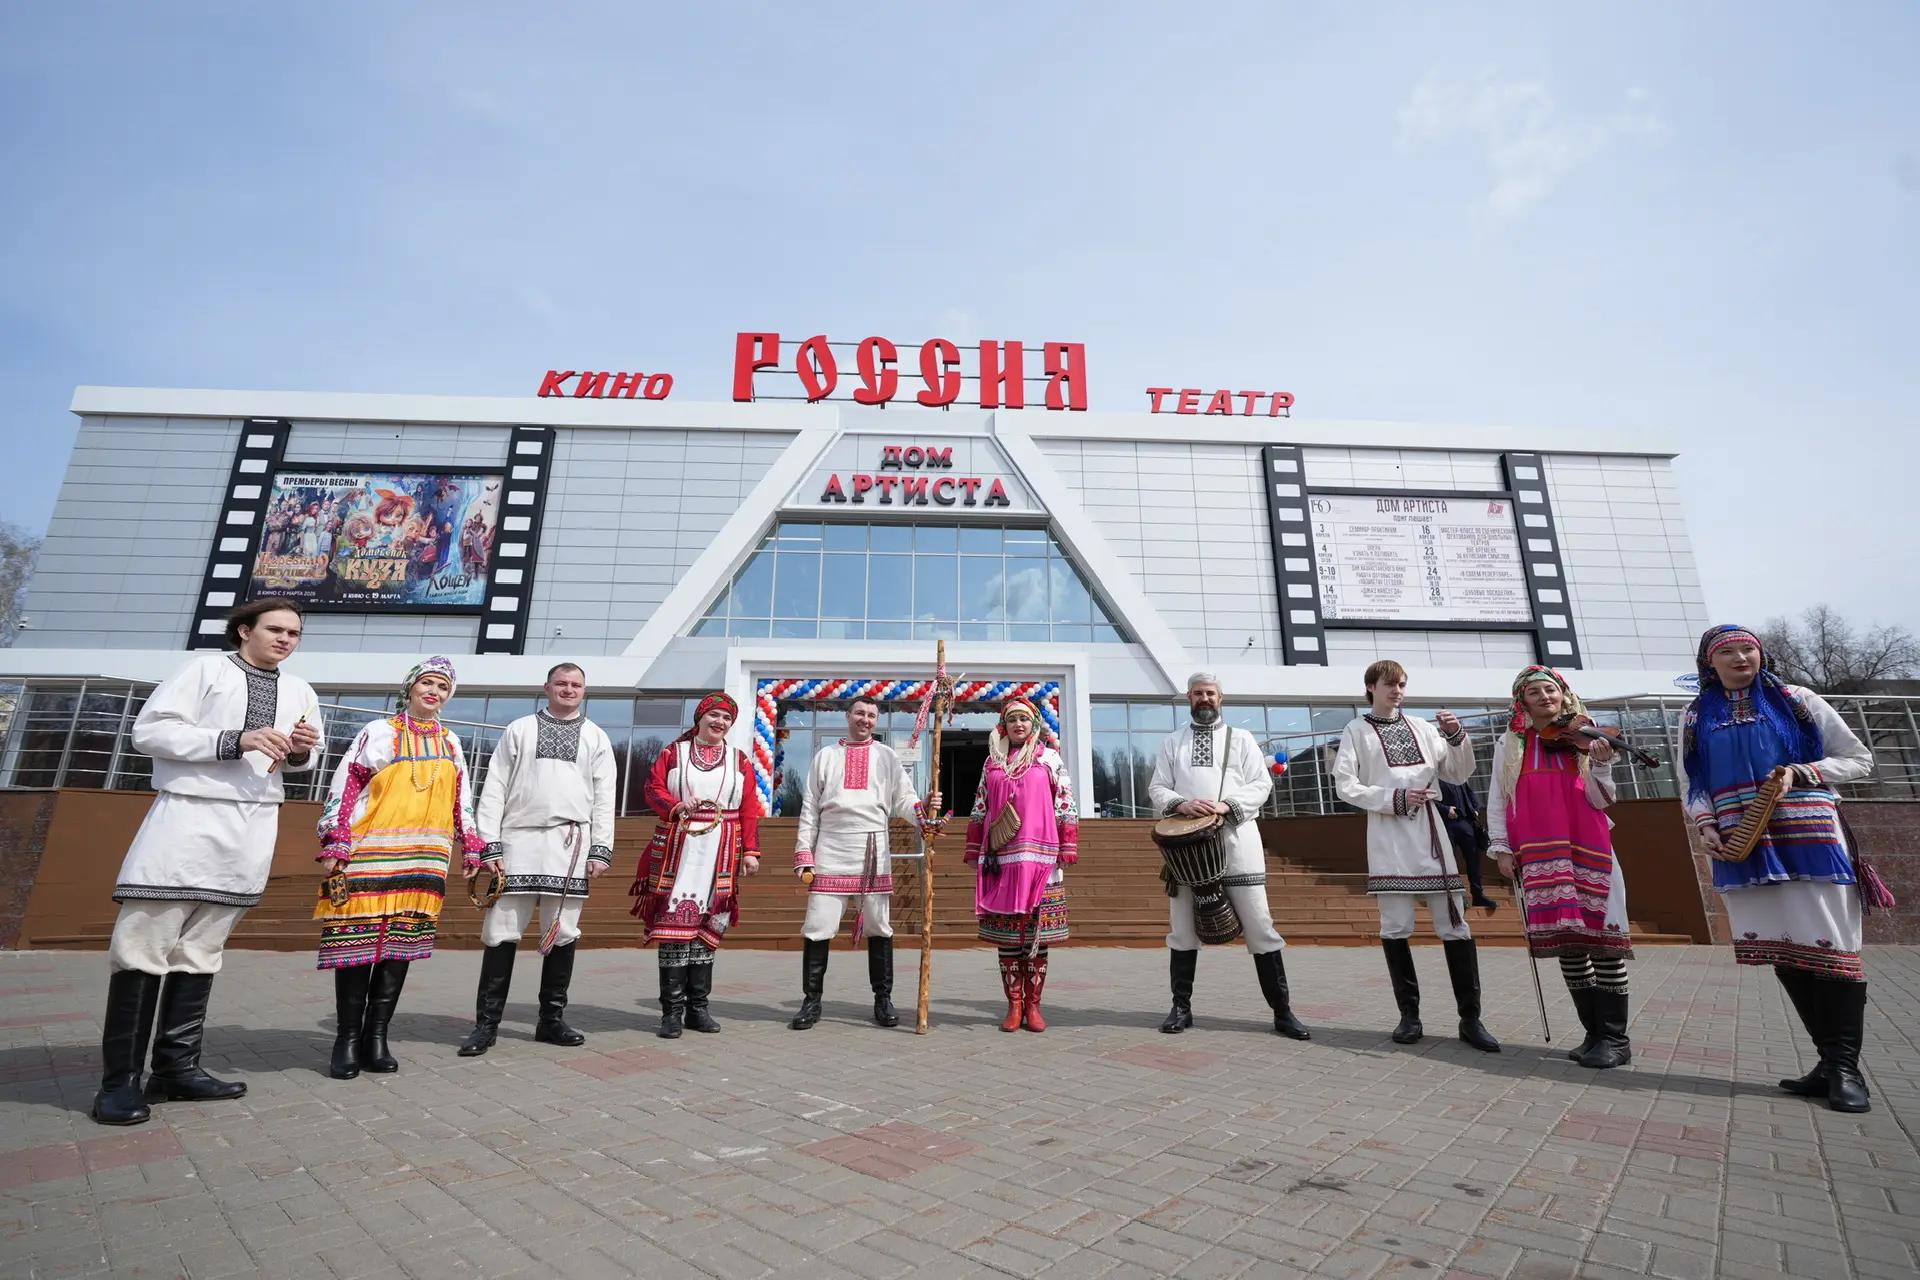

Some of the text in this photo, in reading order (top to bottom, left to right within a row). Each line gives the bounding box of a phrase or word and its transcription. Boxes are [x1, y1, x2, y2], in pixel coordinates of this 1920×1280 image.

[733, 332, 1087, 411] РОССИЯ
[537, 370, 673, 400] КИНО
[1146, 388, 1295, 417] ТЕАТР
[881, 446, 953, 469] ДОМ
[283, 477, 358, 487] ПРЕМЬЕРЫ ВЕСНЫ
[821, 473, 1010, 506] АРТИСТА
[1376, 499, 1448, 514] ДОМ АРТИСТА
[1319, 524, 1325, 533] 3
[1421, 525, 1431, 534] 16
[1321, 544, 1327, 552] 4
[1424, 547, 1434, 555] 23
[344, 559, 409, 581] КУЗЯ
[1319, 566, 1336, 575] 9-10
[1427, 567, 1438, 576] 24
[366, 573, 381, 589] 2
[1325, 585, 1334, 594] 14
[1430, 587, 1440, 596] 28
